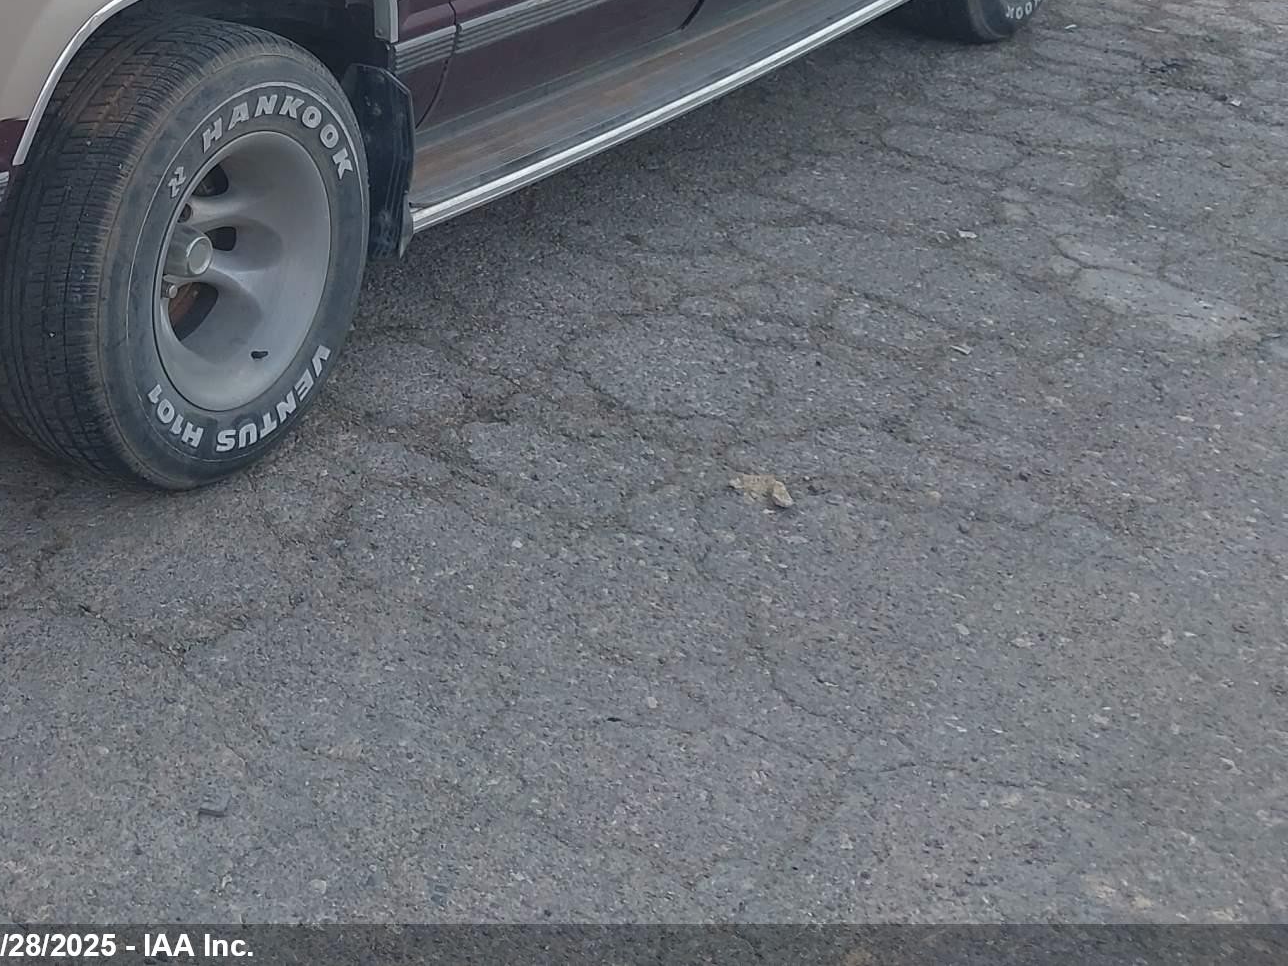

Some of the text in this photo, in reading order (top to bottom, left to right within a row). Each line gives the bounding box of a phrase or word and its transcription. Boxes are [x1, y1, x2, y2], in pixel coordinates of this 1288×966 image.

[201, 95, 354, 181] HANKOOK
[147, 344, 332, 453] VENTUS H101
